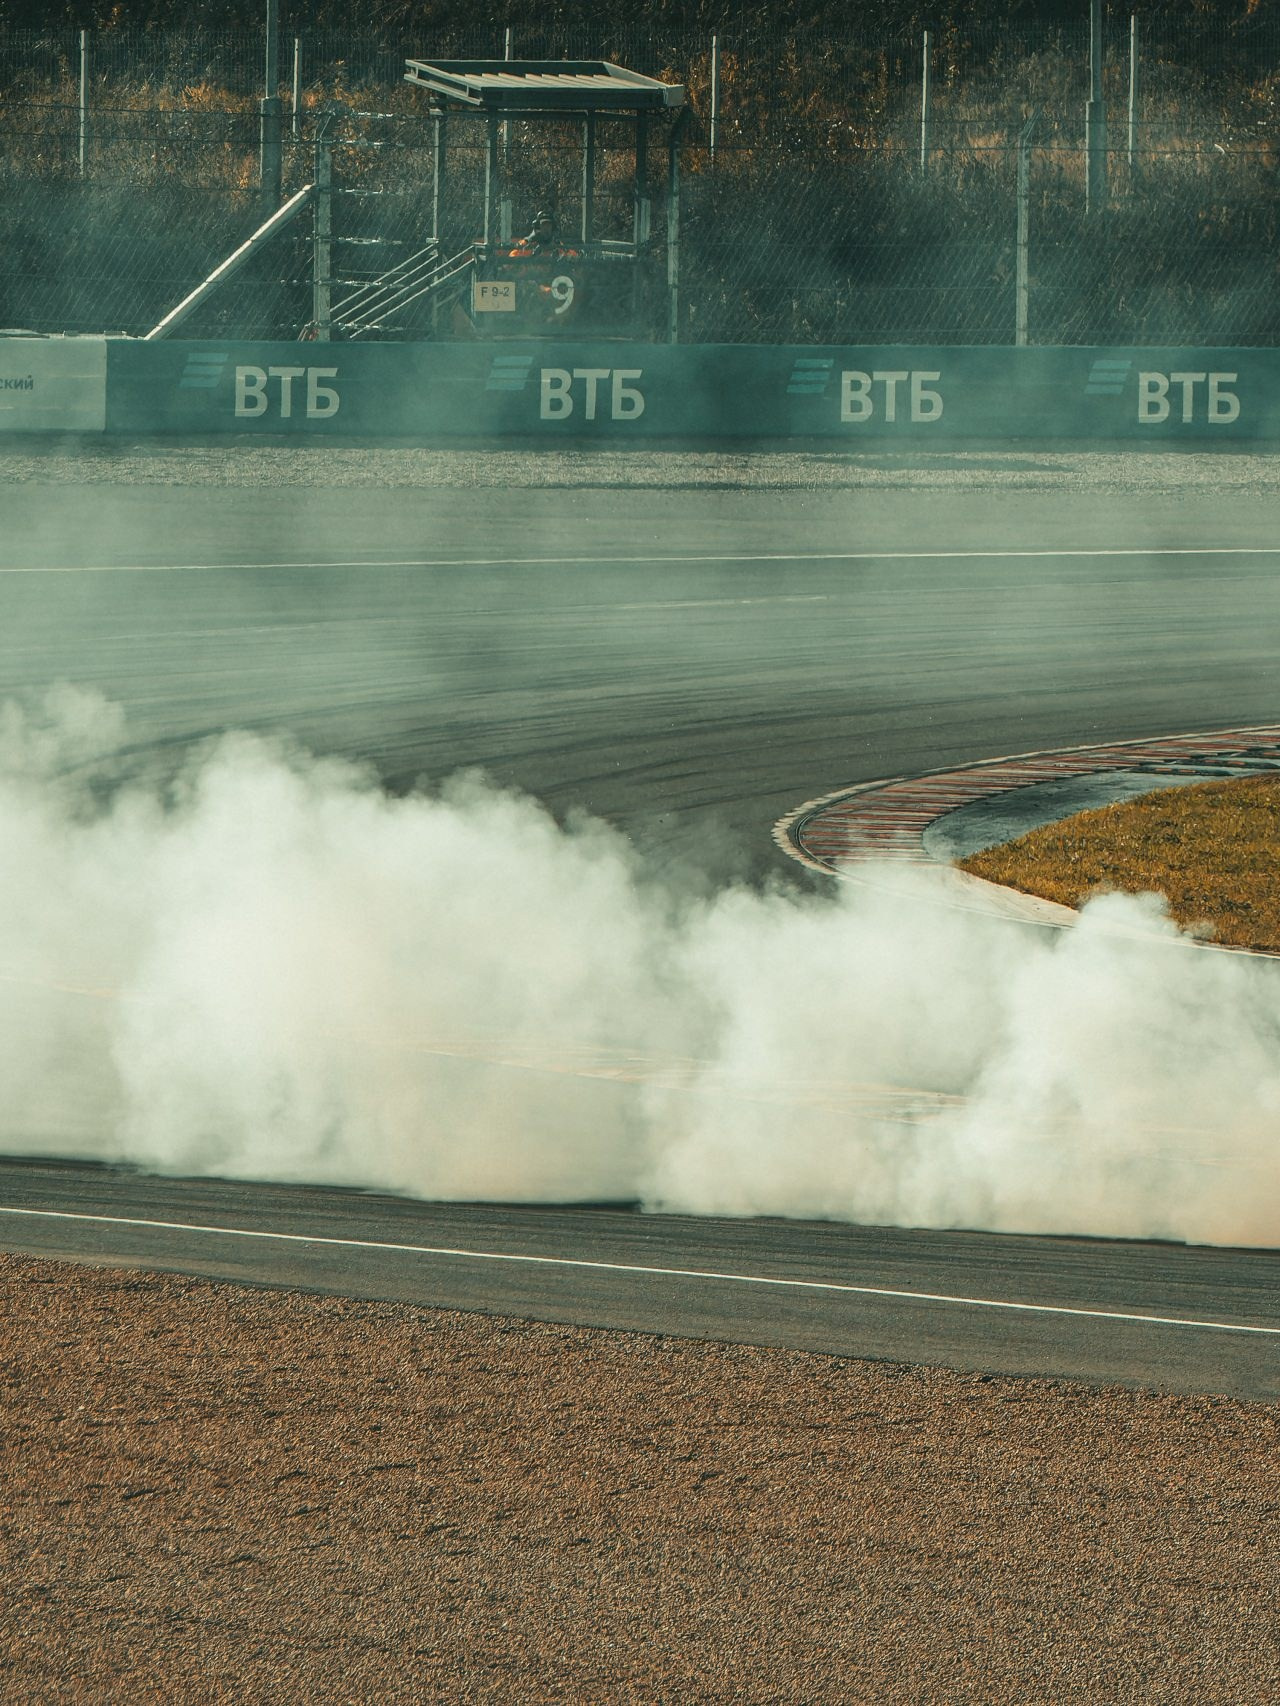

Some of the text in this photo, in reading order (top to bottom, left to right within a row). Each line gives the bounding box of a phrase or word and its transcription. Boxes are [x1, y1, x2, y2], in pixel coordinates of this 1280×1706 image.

[481, 286, 510, 297] F 9-2
[551, 275, 575, 314] 9
[235, 365, 339, 418] ВТБ
[541, 368, 645, 420] ВТБ
[841, 371, 944, 422] ВТБ
[1138, 371, 1240, 423] ВТБ
